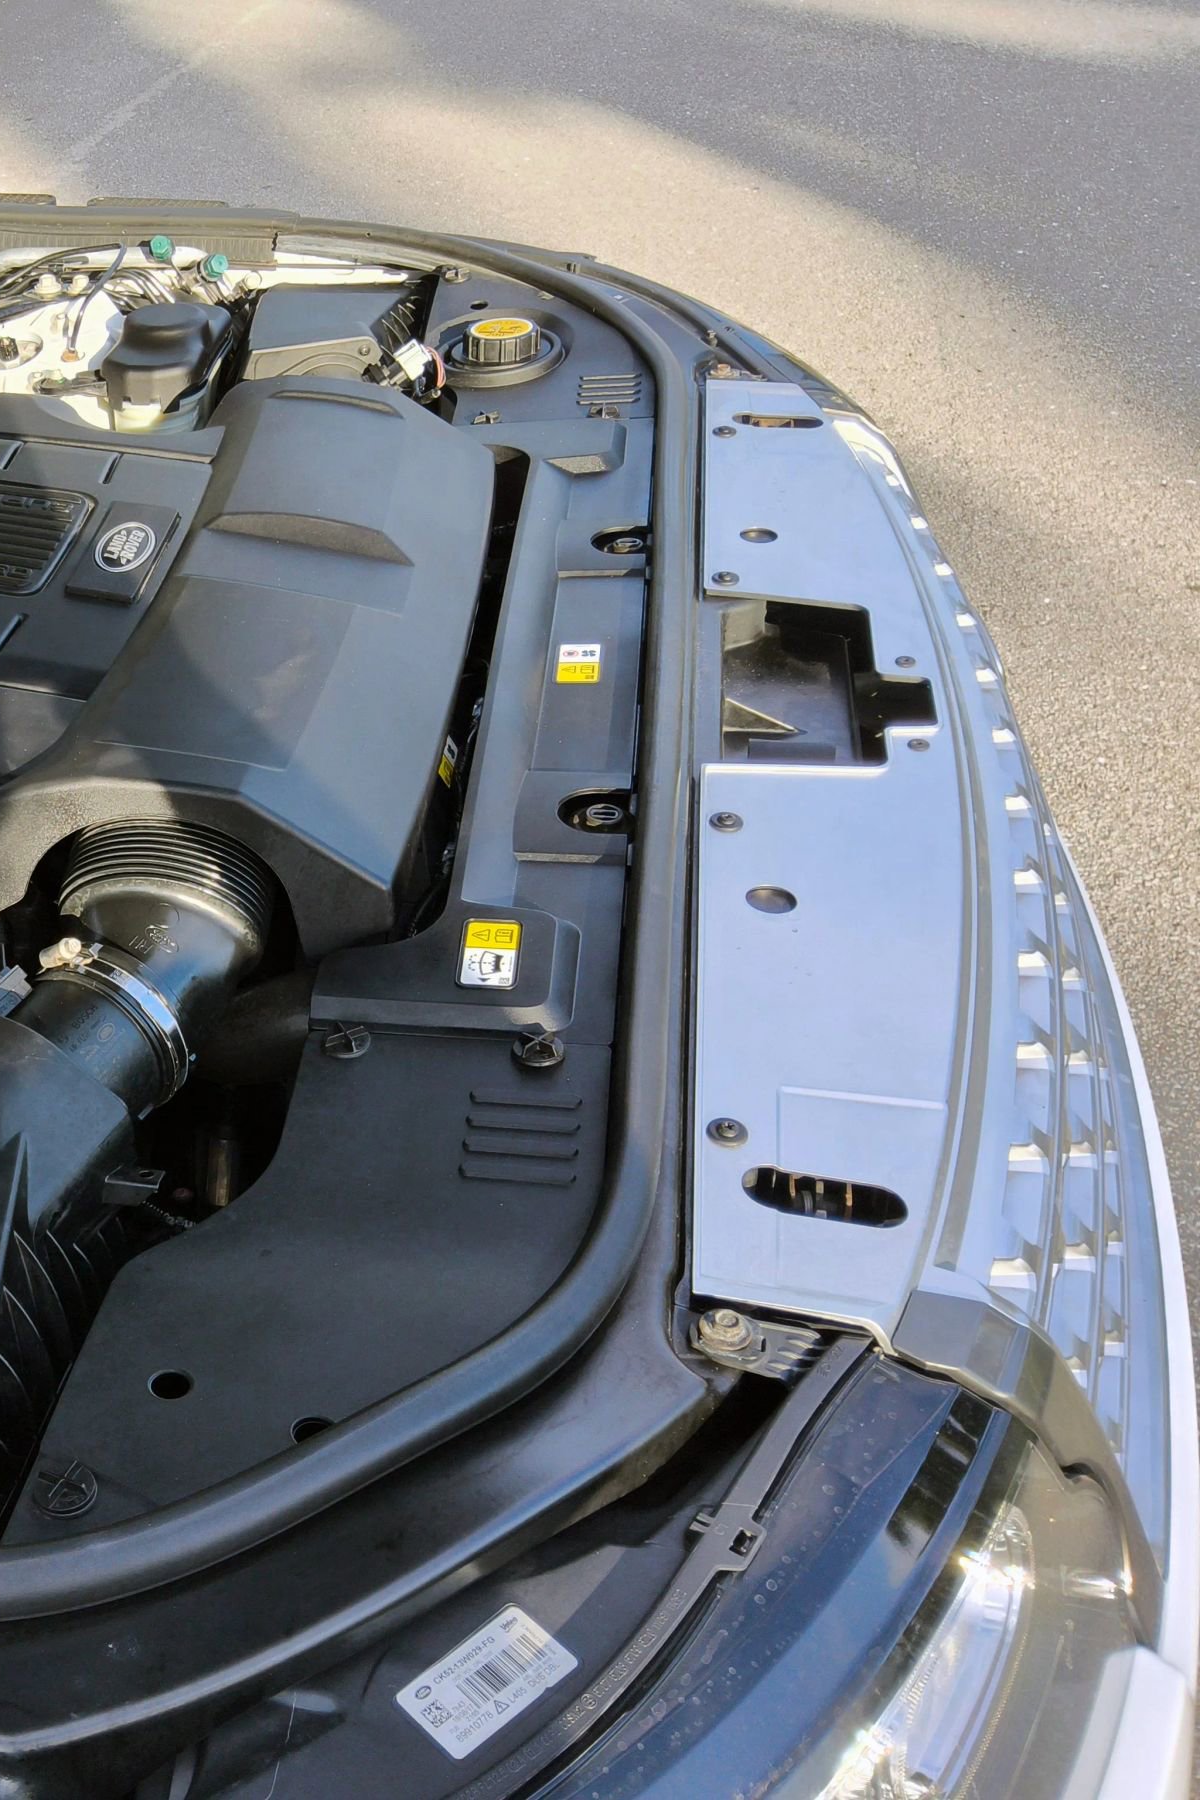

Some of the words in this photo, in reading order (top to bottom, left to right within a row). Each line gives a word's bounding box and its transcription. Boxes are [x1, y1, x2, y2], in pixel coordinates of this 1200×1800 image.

[103, 531, 127, 560] LAND
[120, 529, 146, 562] ROVER
[510, 1687, 527, 1704] L405
